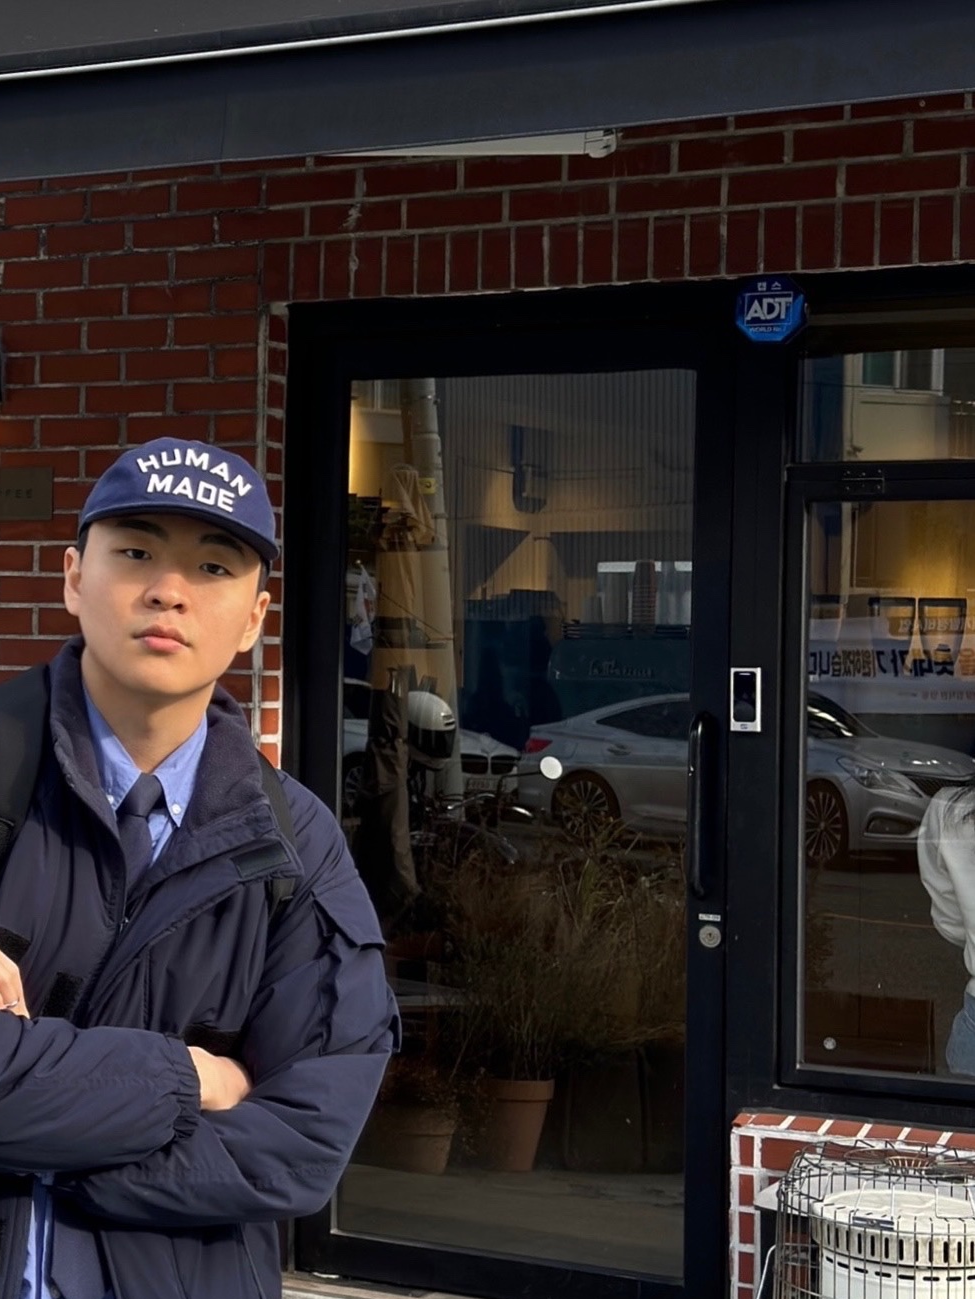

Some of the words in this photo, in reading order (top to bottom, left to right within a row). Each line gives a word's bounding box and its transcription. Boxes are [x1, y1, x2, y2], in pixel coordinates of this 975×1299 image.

[745, 297, 793, 320] ADT
[137, 448, 252, 497] HUMAN
[147, 473, 236, 513] MADE
